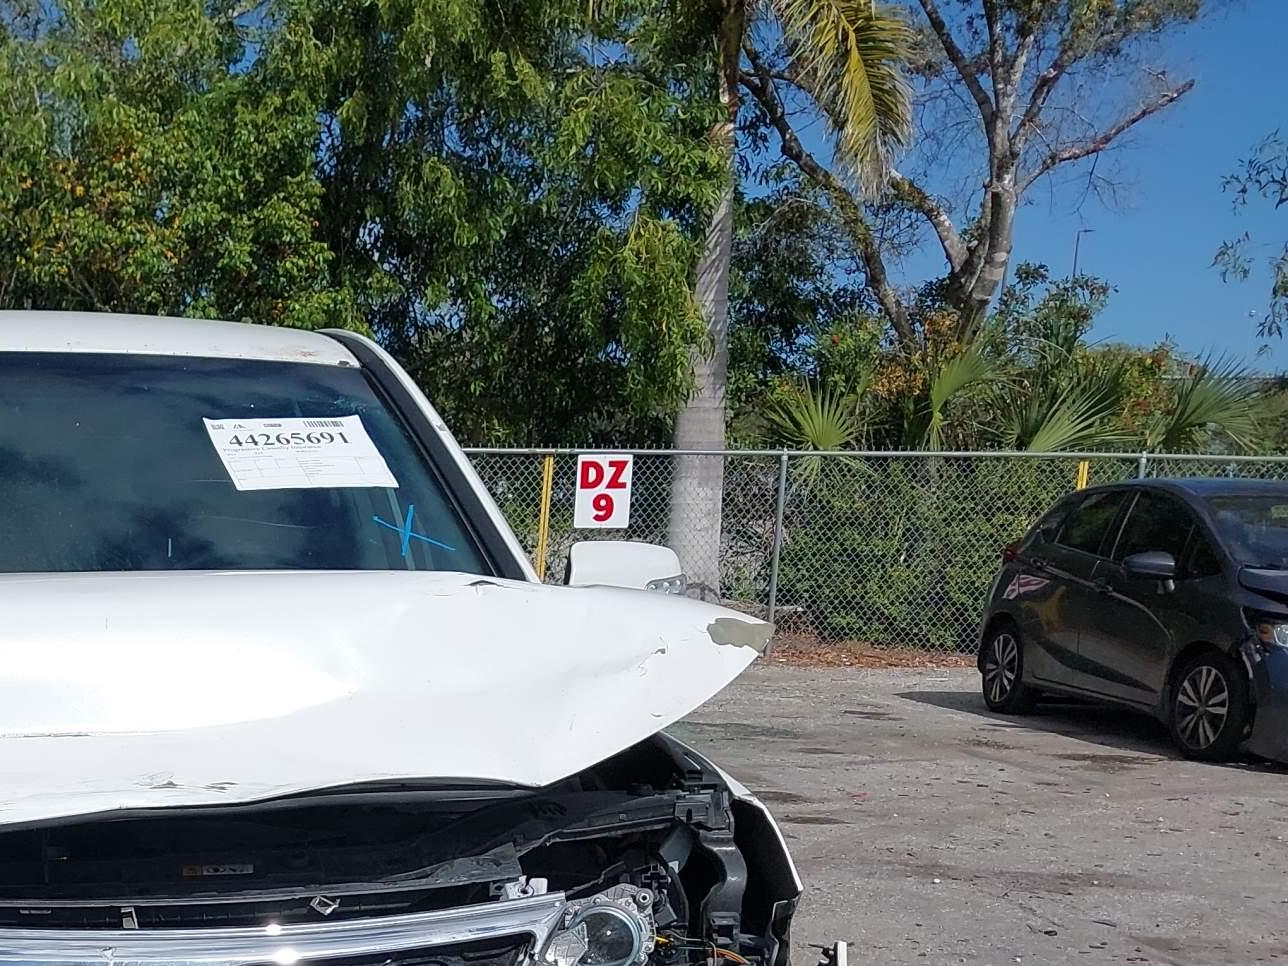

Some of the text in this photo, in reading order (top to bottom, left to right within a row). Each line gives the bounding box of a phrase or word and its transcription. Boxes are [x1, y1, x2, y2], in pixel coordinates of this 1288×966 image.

[229, 431, 352, 446] 44265691
[579, 460, 629, 489] DZ
[592, 493, 614, 522] 9
